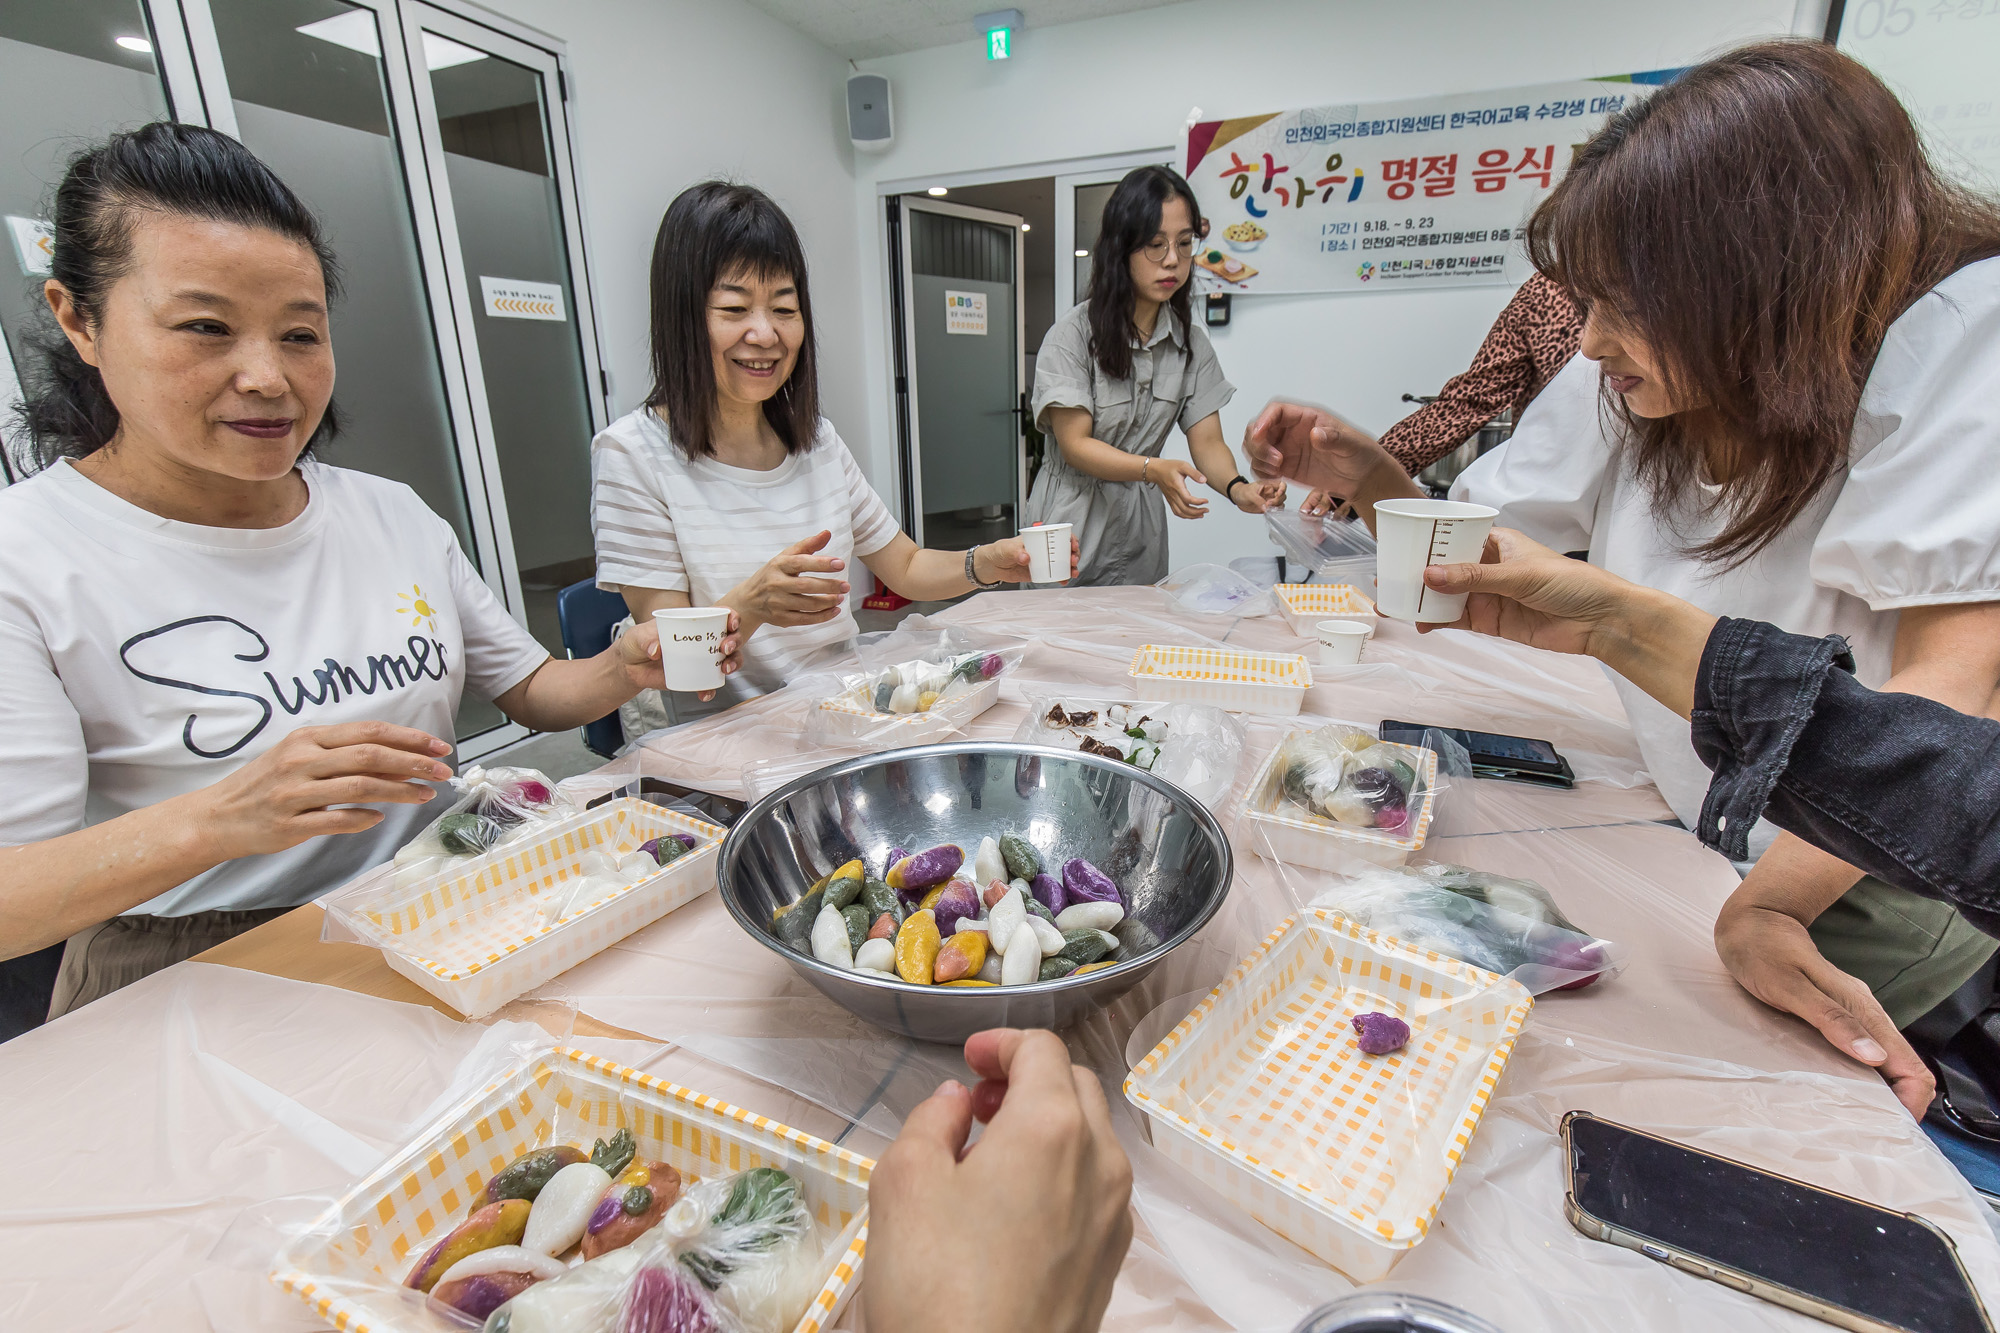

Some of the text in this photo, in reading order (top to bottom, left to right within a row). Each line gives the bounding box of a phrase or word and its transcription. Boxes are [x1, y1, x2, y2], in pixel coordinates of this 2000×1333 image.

[1853, 0, 1916, 40] 05
[1285, 95, 1626, 144] 인천외국인종합지원센터 한국어교육 수강생 대상
[1219, 144, 1556, 218] 한가위 명절 음식
[1362, 230, 1488, 250] 인천외국인종합지원센터
[1490, 228, 1511, 242] 8층
[1363, 220, 1390, 233] 9.18.
[1380, 255, 1505, 272] 인천외국인종합지원센터
[673, 633, 703, 642] Love
[120, 615, 449, 758] Summer
